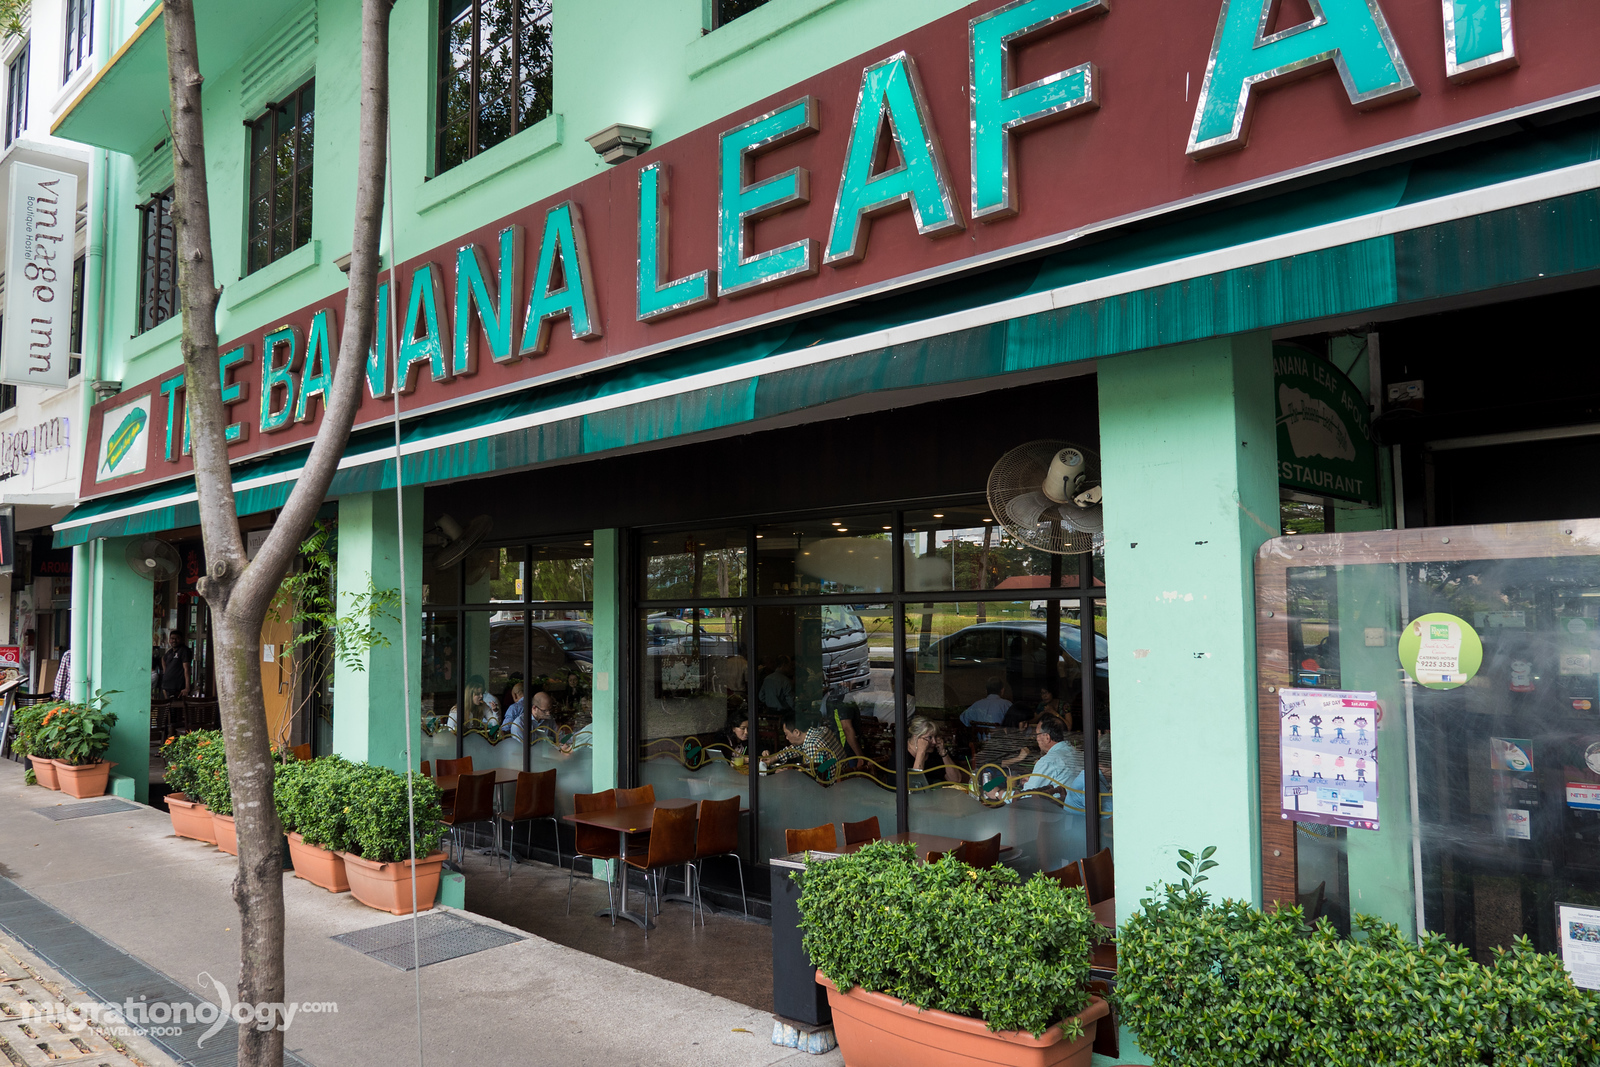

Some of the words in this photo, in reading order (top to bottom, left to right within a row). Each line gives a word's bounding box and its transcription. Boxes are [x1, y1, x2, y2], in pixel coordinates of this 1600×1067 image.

[25, 196, 36, 233] Boutique
[160, 343, 253, 462] TE
[637, 0, 1111, 323] LEAF
[25, 234, 34, 261] Hostel
[29, 317, 53, 375] inn
[1273, 356, 1309, 378] ANANA
[1312, 363, 1338, 394] LEAF
[1341, 390, 1371, 441] APOLO
[1277, 460, 1363, 495] ESTAURANT
[40, 561, 72, 574] AROM
